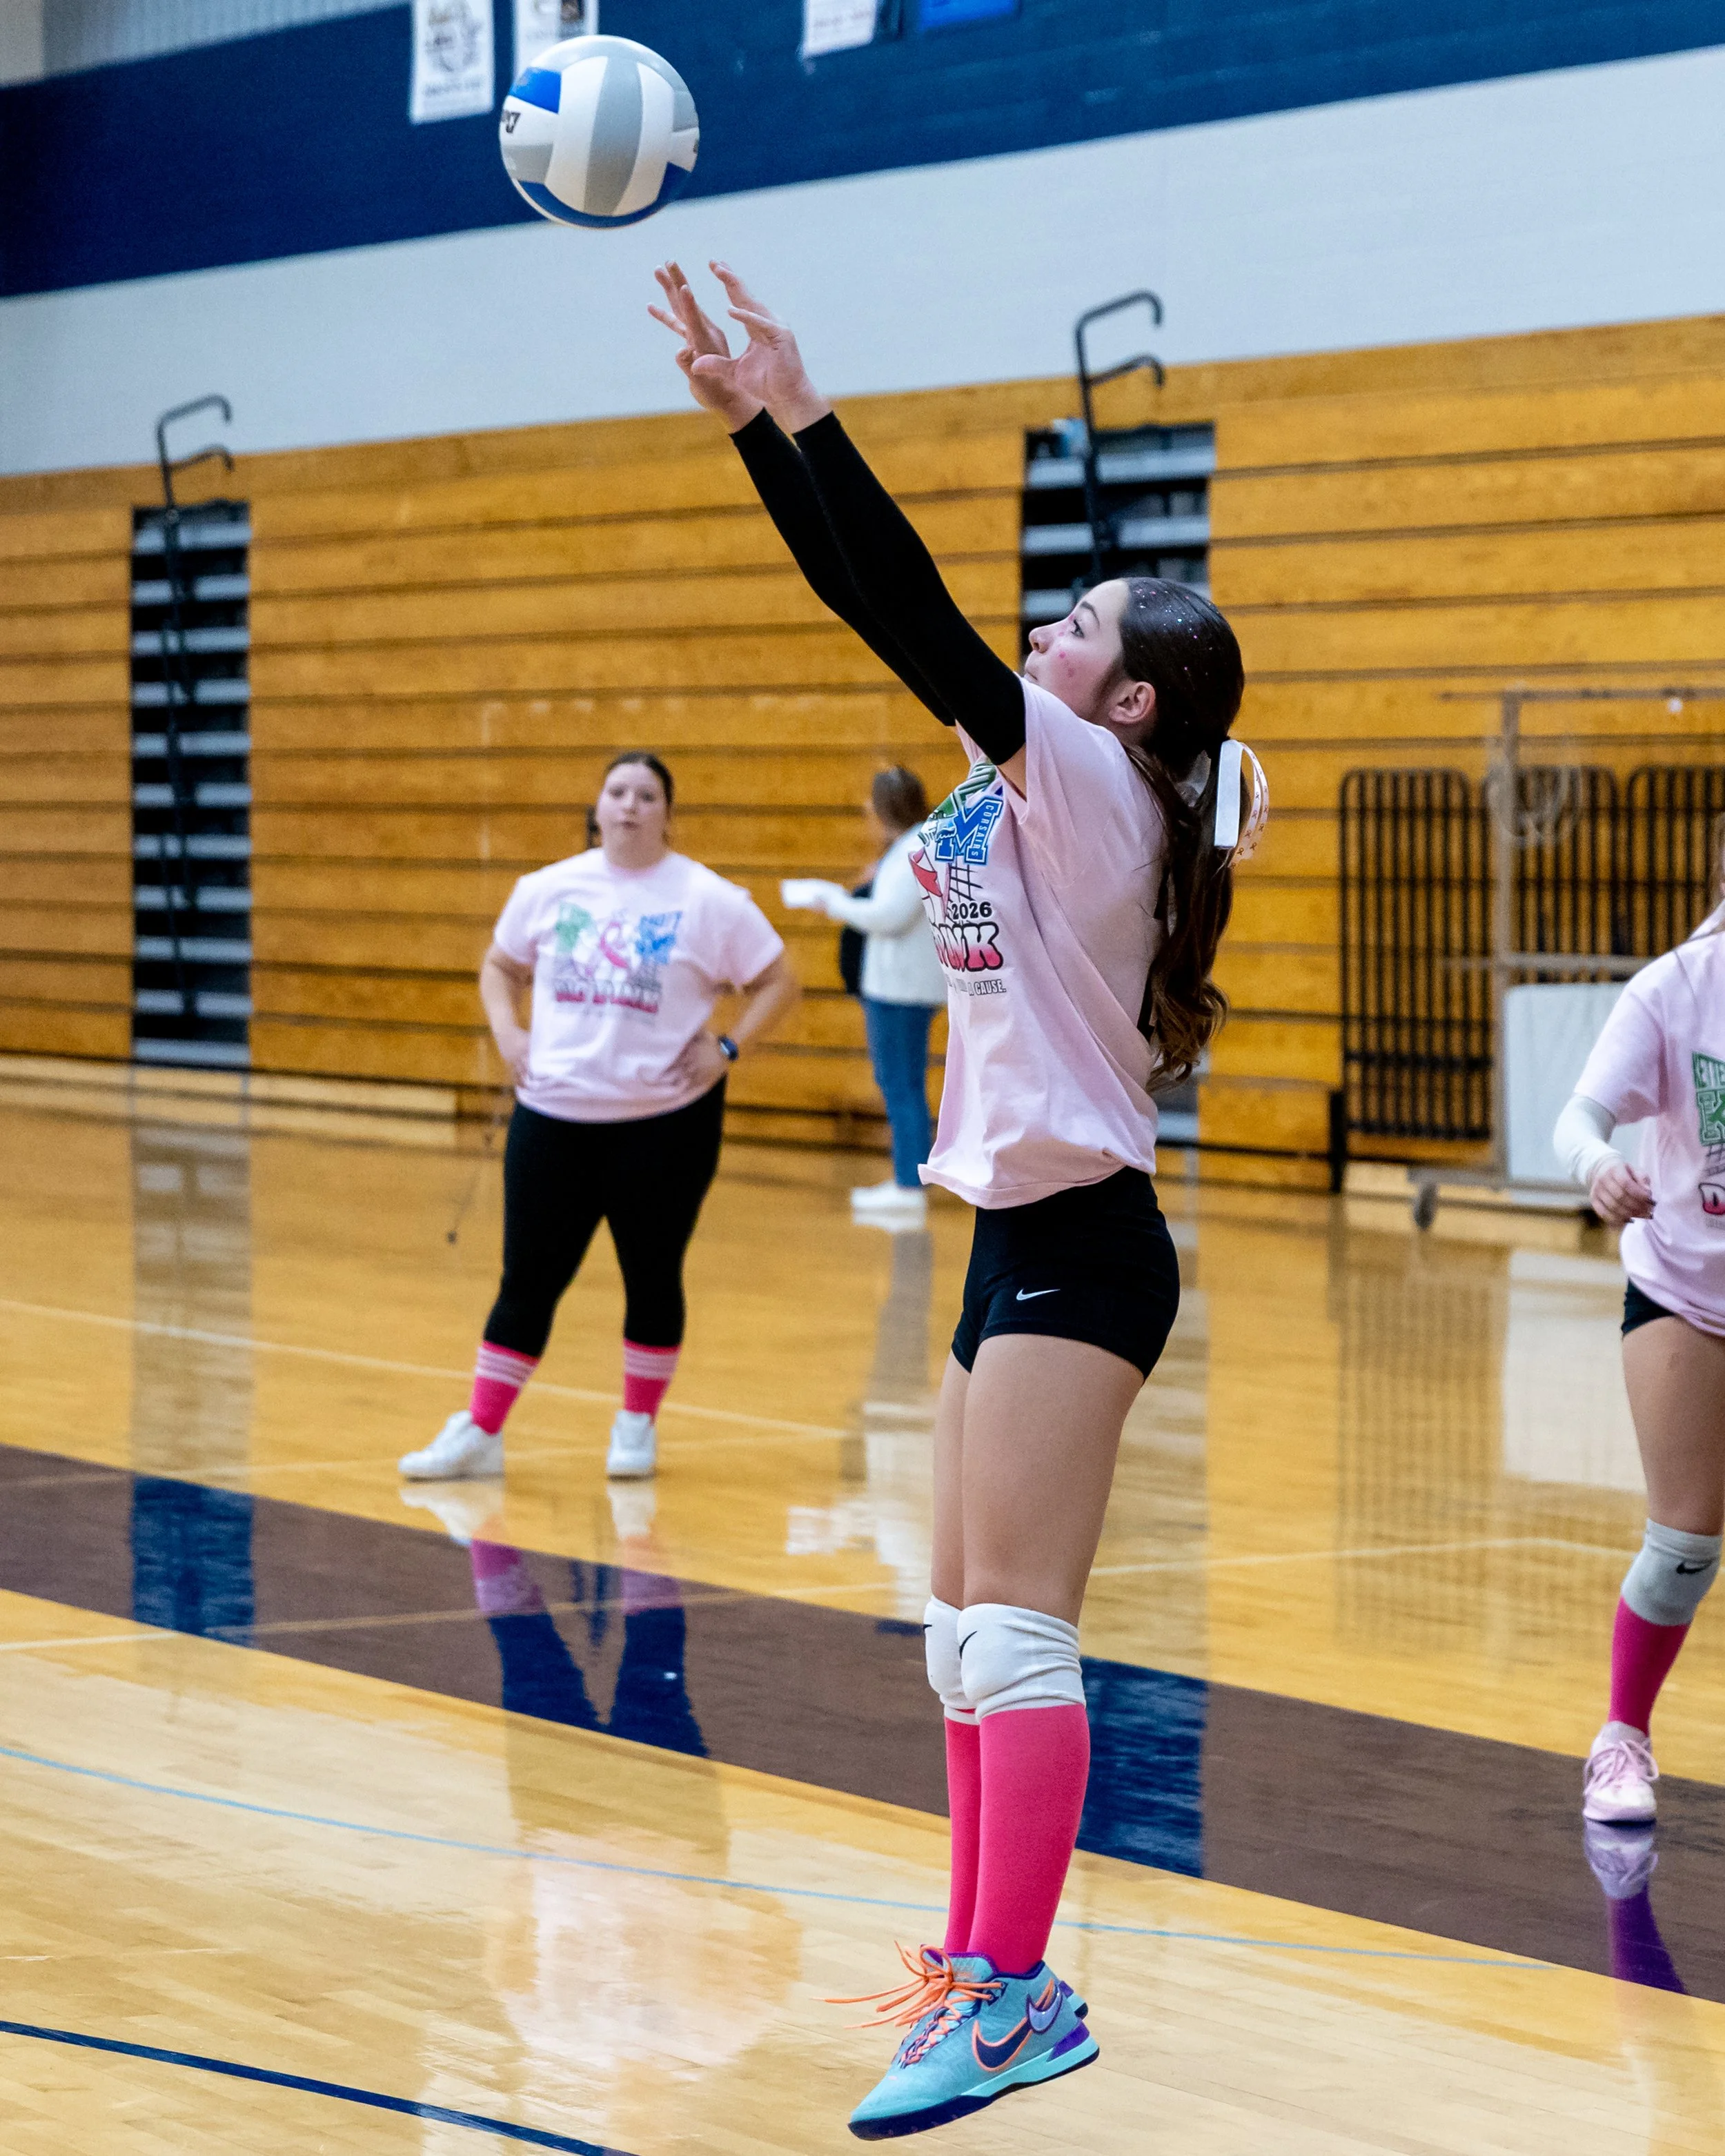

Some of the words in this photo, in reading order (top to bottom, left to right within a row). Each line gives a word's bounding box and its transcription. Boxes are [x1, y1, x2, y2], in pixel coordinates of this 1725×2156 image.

[971, 804, 995, 856] CORSAIRS
[952, 901, 993, 920] 2026
[974, 979, 1007, 996] CAUSE.
